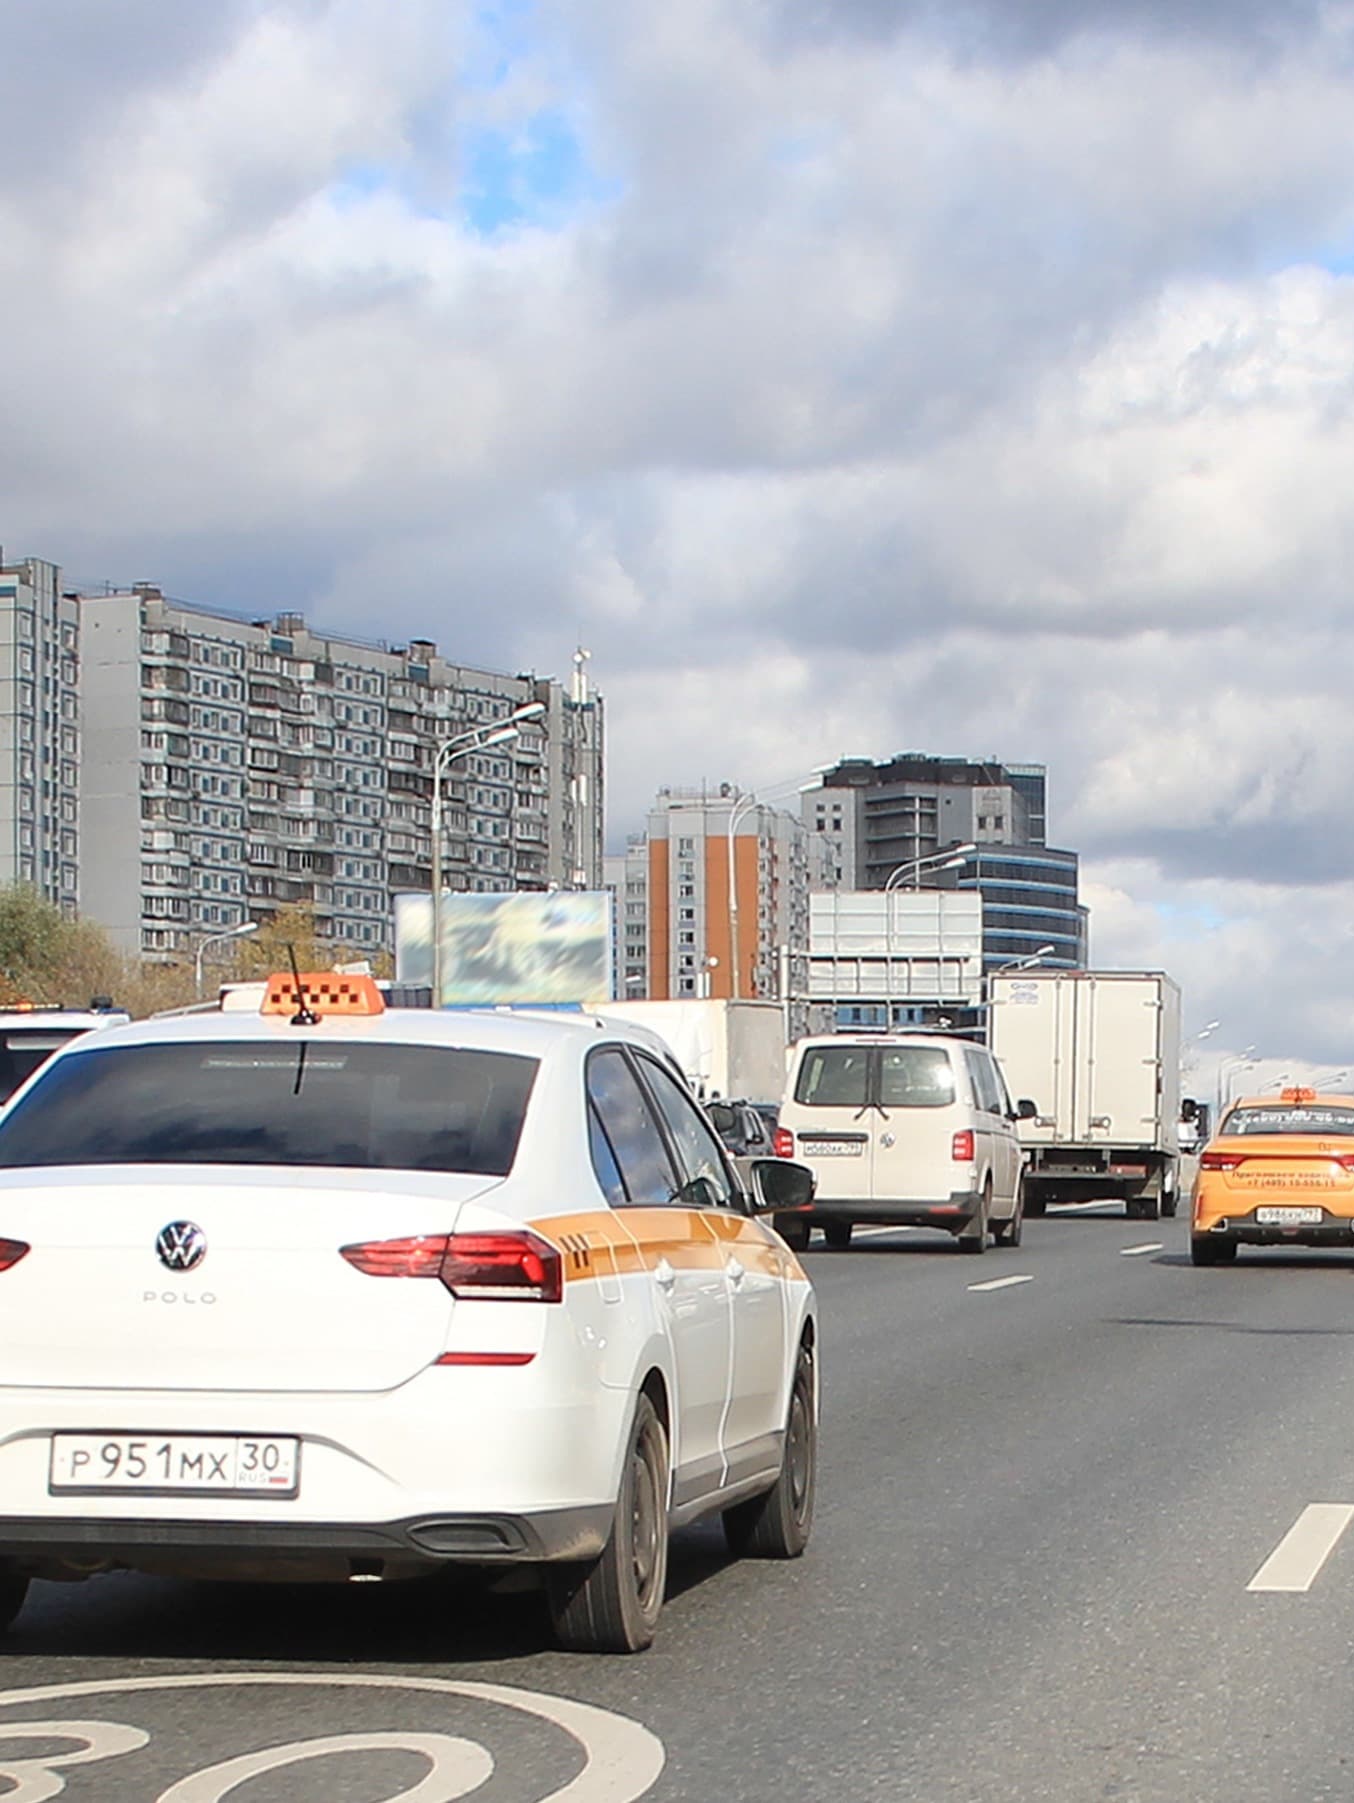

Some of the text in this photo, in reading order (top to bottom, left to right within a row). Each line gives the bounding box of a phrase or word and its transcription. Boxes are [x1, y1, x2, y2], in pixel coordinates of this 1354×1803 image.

[143, 1291, 218, 1305] POLO
[70, 1442, 280, 1481] Р951МХ 30
[238, 1472, 267, 1484] RUS
